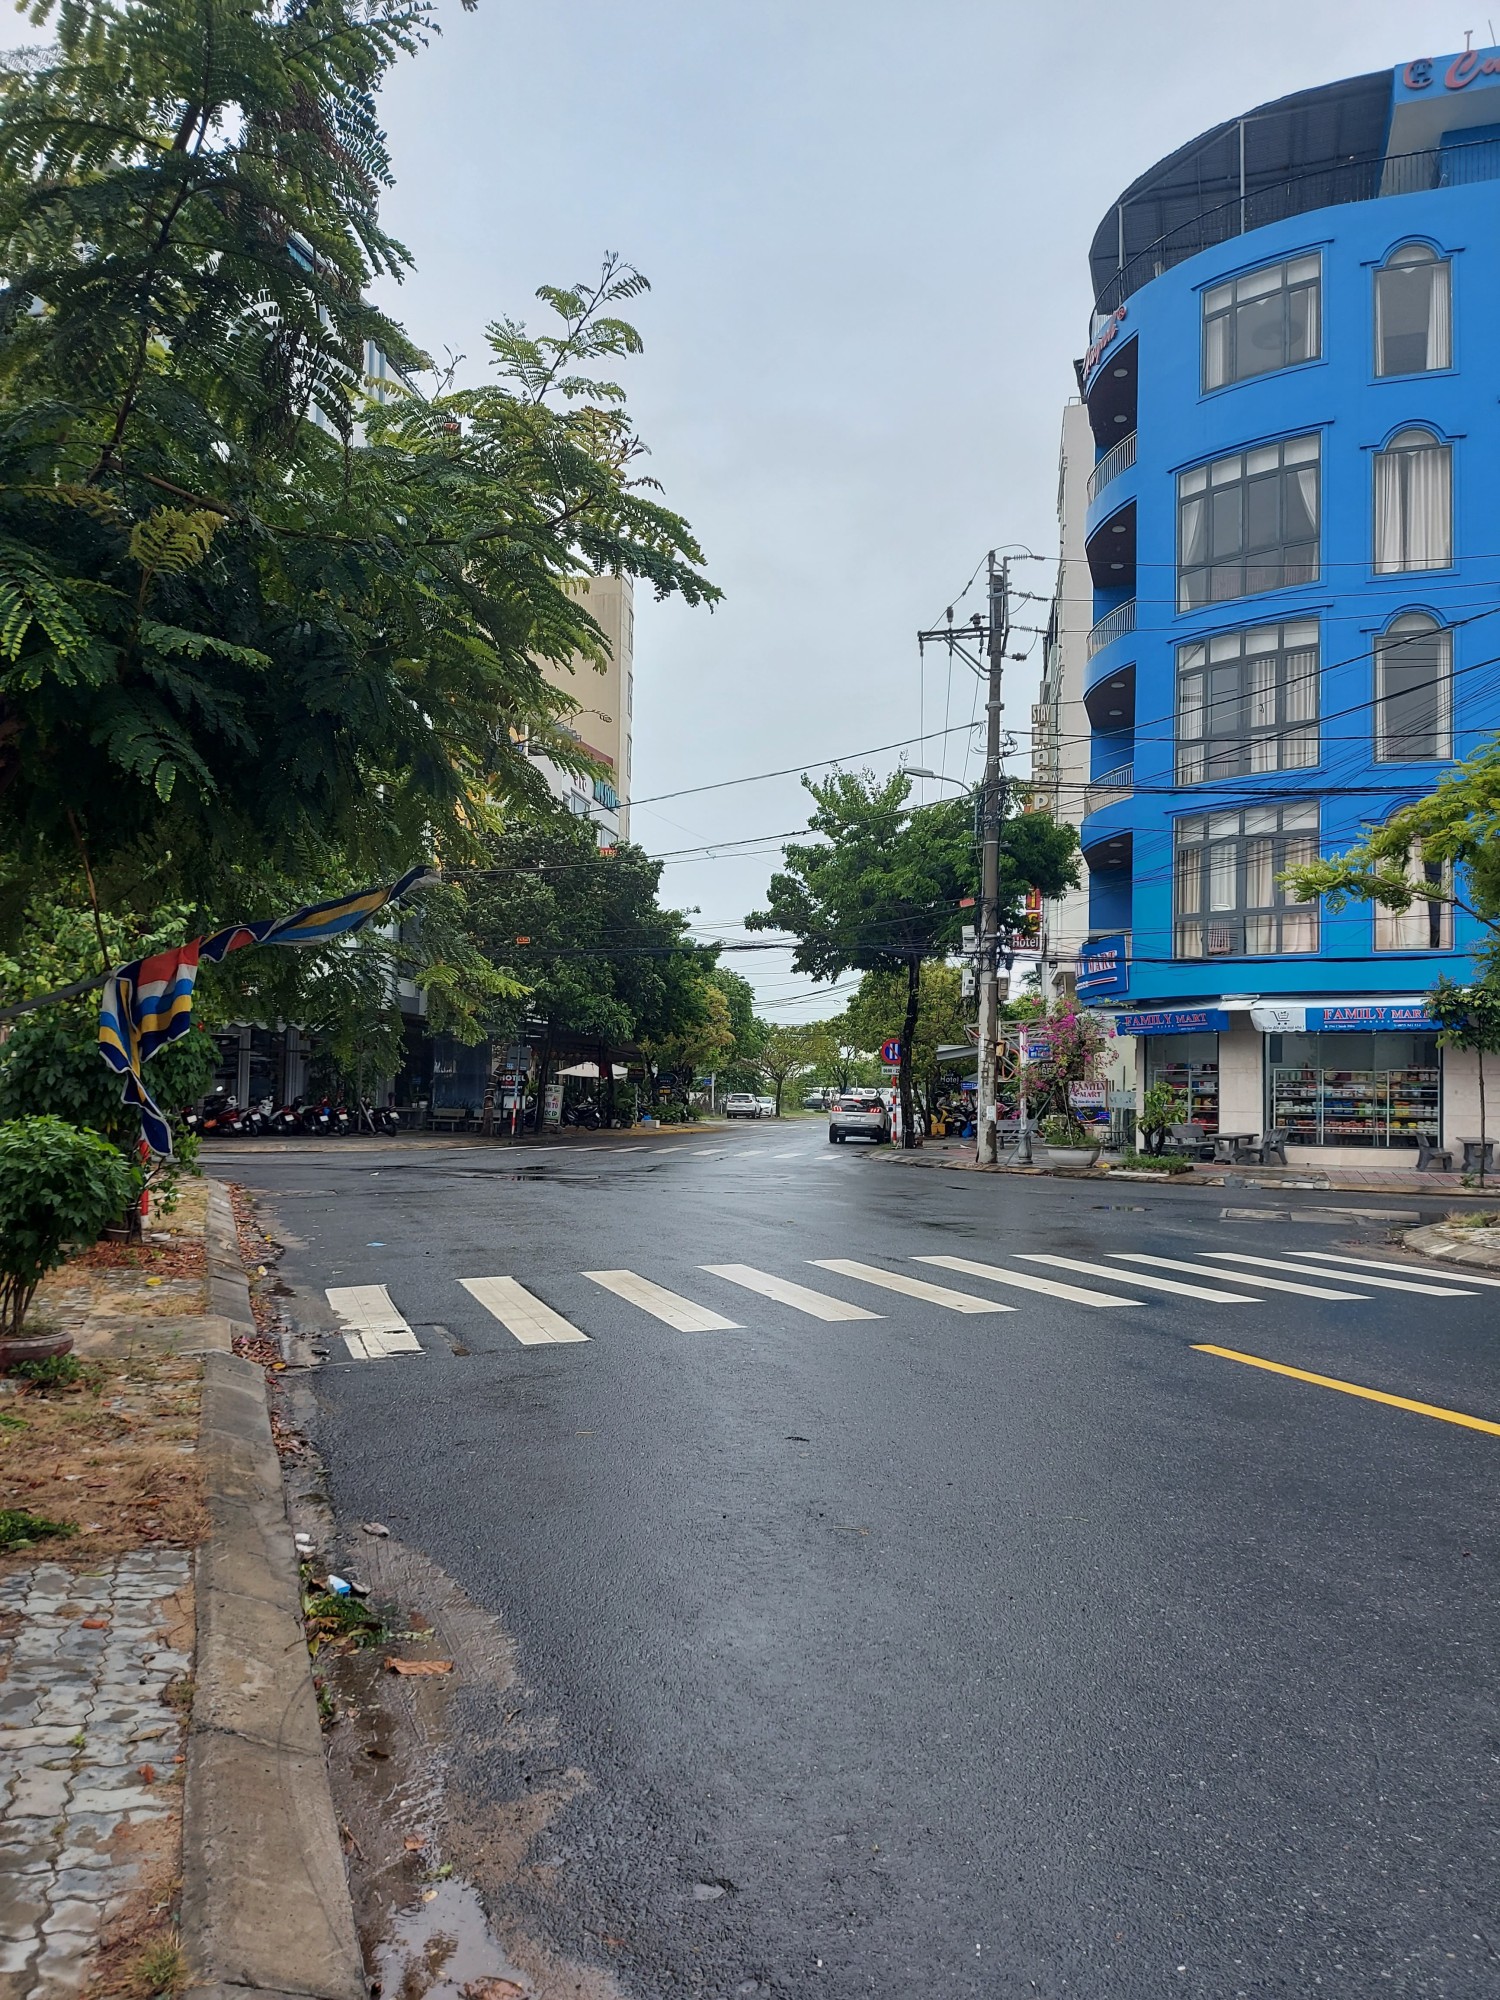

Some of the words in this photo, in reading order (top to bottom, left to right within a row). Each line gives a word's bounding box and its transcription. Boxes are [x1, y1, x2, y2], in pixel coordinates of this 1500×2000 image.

[1032, 704, 1050, 722] STAY
[1012, 936, 1039, 948] Hotel
[1124, 1014, 1172, 1027] FAMILY
[1175, 1013, 1207, 1024] MART
[1324, 1007, 1387, 1020] FAMILY
